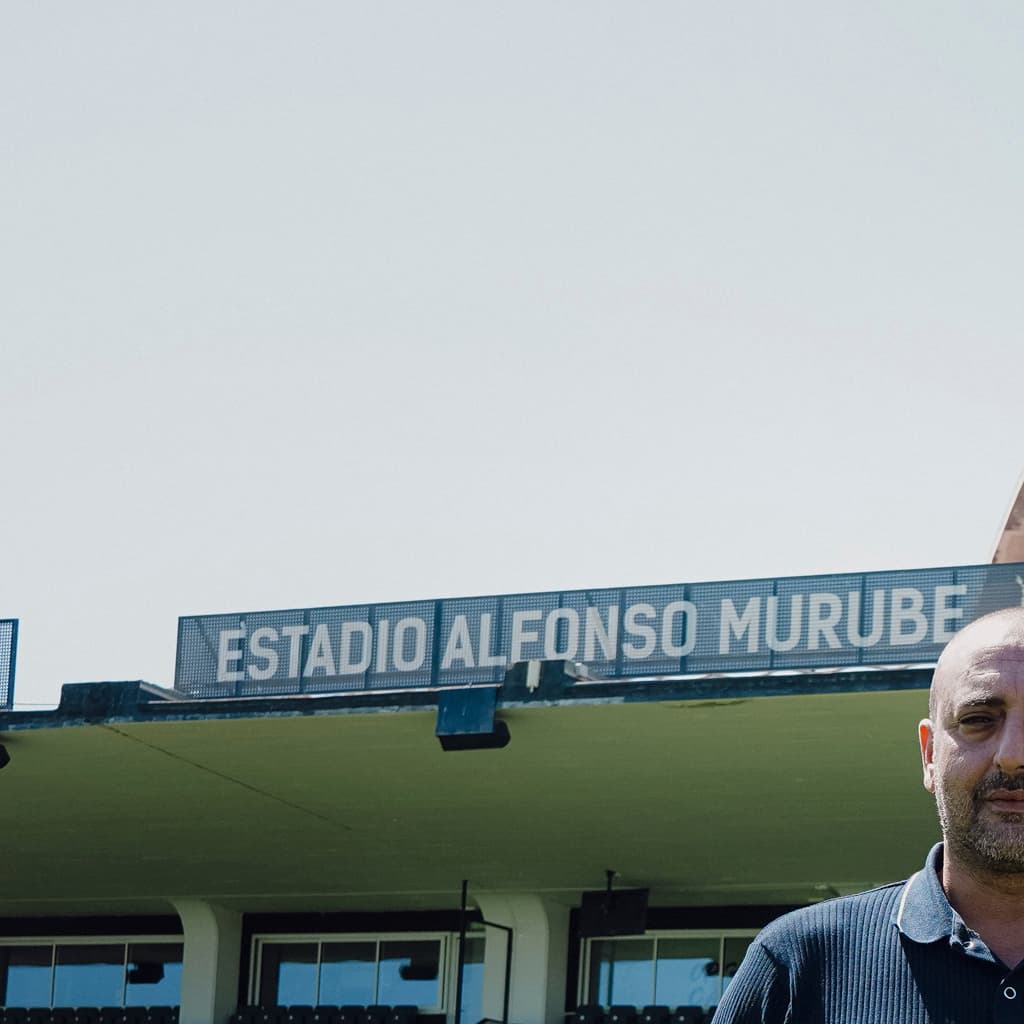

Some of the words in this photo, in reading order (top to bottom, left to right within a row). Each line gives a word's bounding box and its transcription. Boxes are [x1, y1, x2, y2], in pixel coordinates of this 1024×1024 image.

[216, 617, 427, 683] ESTADIO
[440, 600, 698, 670] ALFONSO
[718, 584, 969, 656] MURUBE
